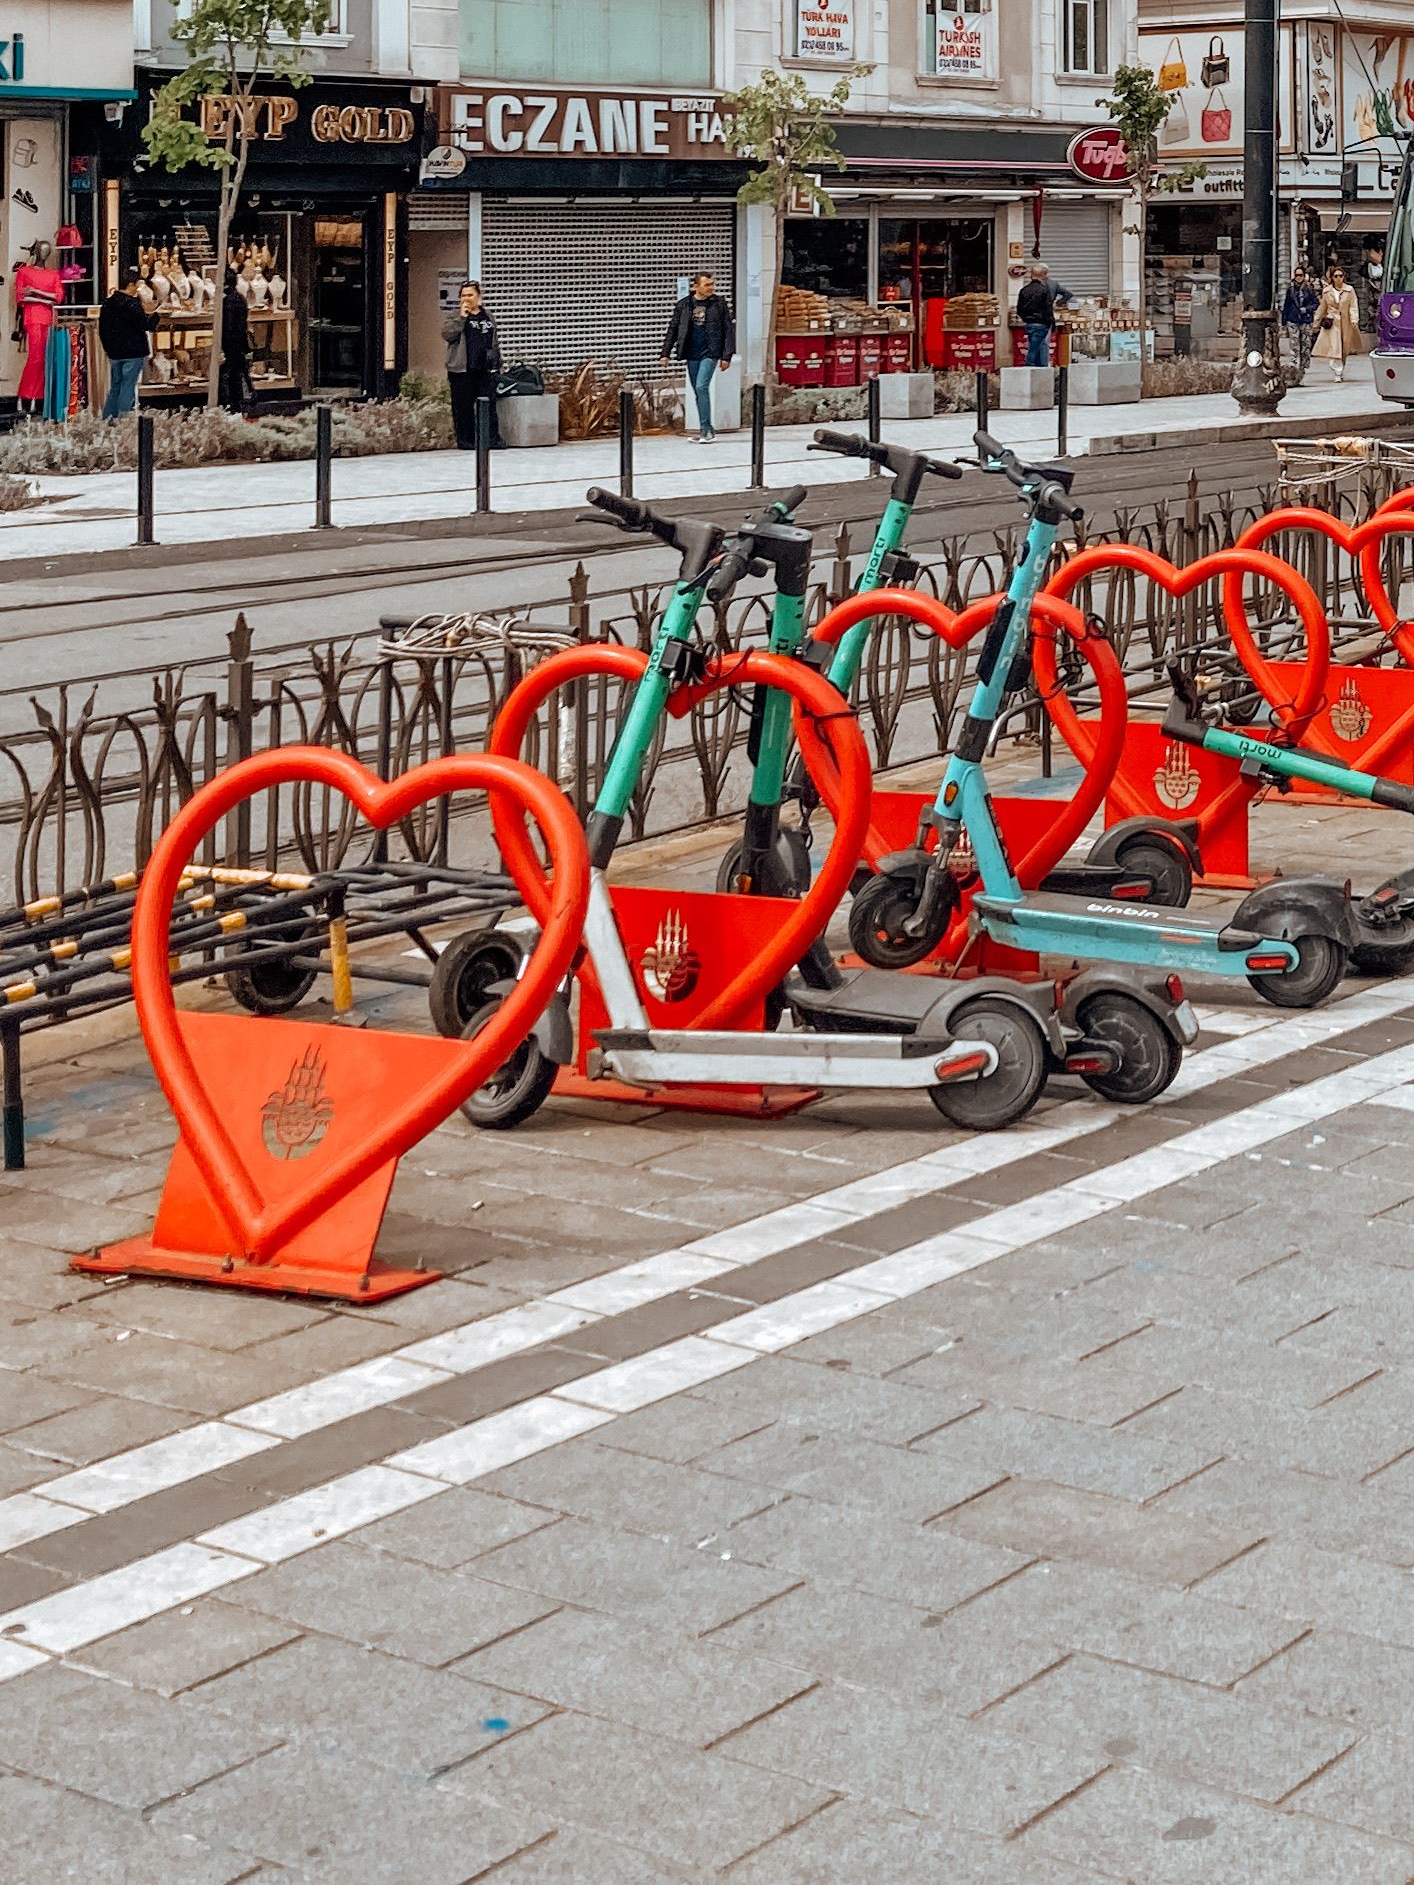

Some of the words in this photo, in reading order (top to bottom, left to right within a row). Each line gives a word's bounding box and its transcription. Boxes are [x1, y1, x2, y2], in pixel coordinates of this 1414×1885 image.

[311, 104, 416, 143] GOLD
[451, 93, 670, 154] ECZANE
[1204, 179, 1245, 193] outfitt
[1086, 903, 1160, 919] binbin
